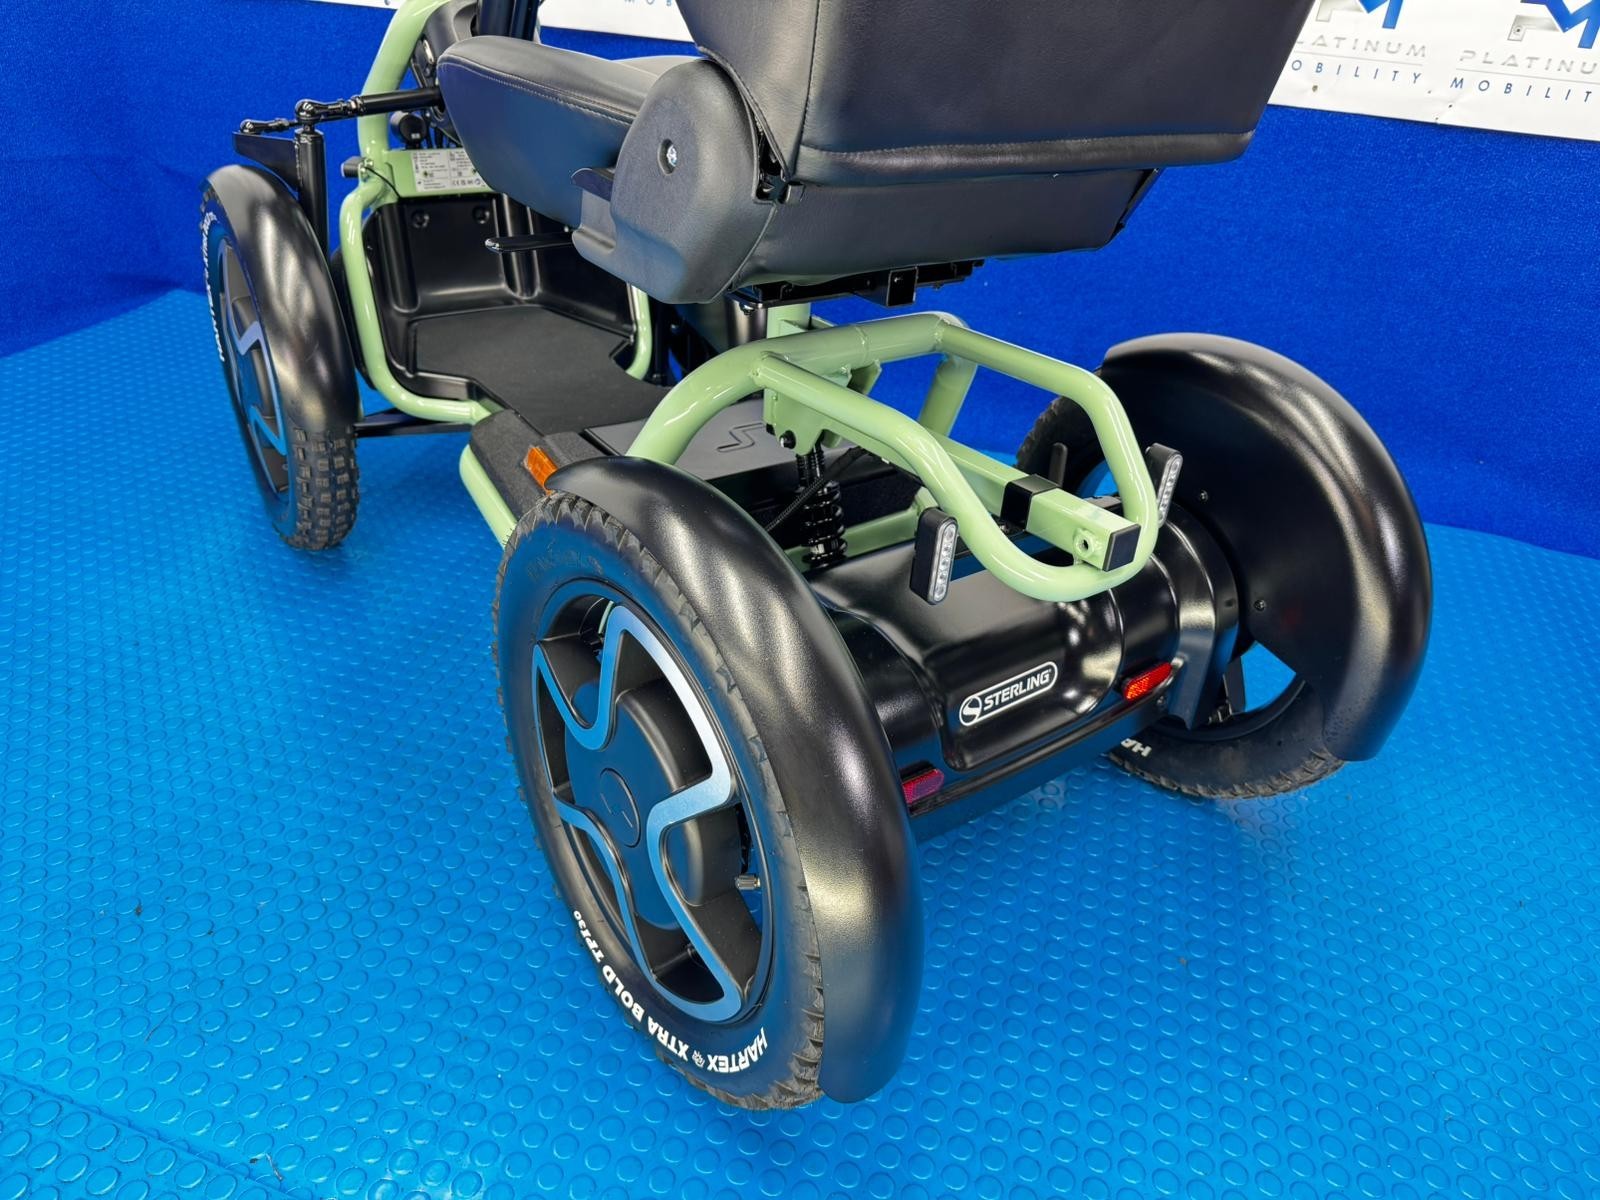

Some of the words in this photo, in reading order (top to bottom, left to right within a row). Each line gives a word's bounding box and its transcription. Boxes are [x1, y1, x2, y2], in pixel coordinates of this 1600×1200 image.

[1296, 34, 1427, 58] ATINUM
[1291, 59, 1422, 84] OBILITY
[1459, 49, 1598, 75] PLATINU
[1449, 76, 1593, 103] MOBILIT
[983, 668, 1051, 711] STERLING
[1120, 737, 1152, 756] HA
[602, 964, 645, 1023] BOLD
[647, 1015, 689, 1062] XTRA
[706, 1026, 768, 1073] HARTEX
